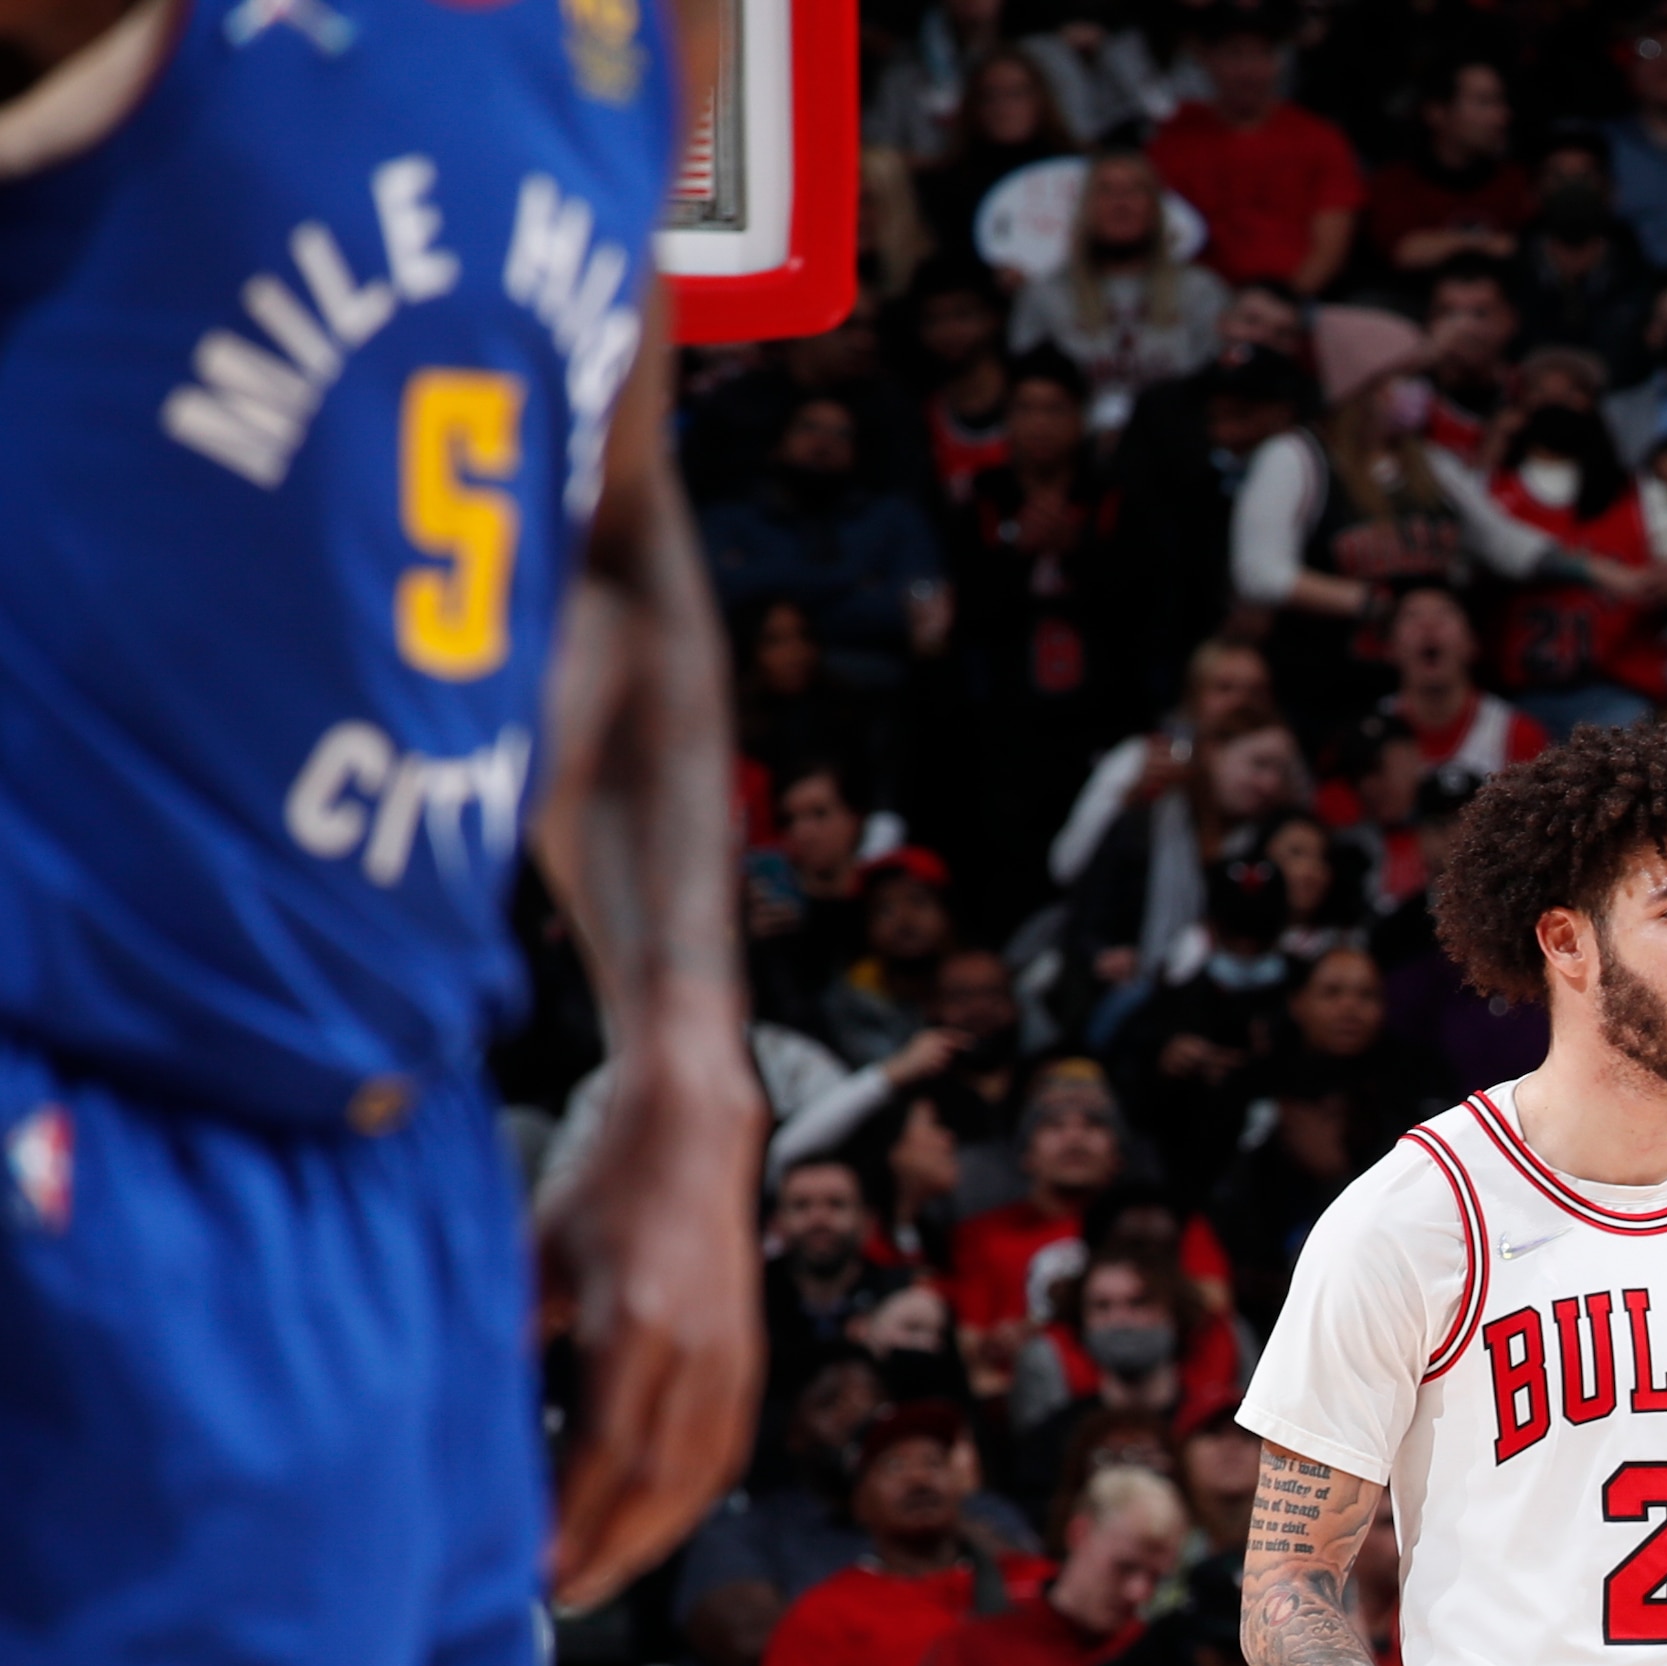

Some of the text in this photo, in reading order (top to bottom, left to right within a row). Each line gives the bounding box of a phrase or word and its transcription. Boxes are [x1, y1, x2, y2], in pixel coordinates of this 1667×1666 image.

[162, 155, 461, 489] MILE
[396, 367, 528, 682] 5
[285, 719, 533, 888] CITY
[1293, 1542, 1314, 1554] me
[1315, 1488, 1330, 1500] of
